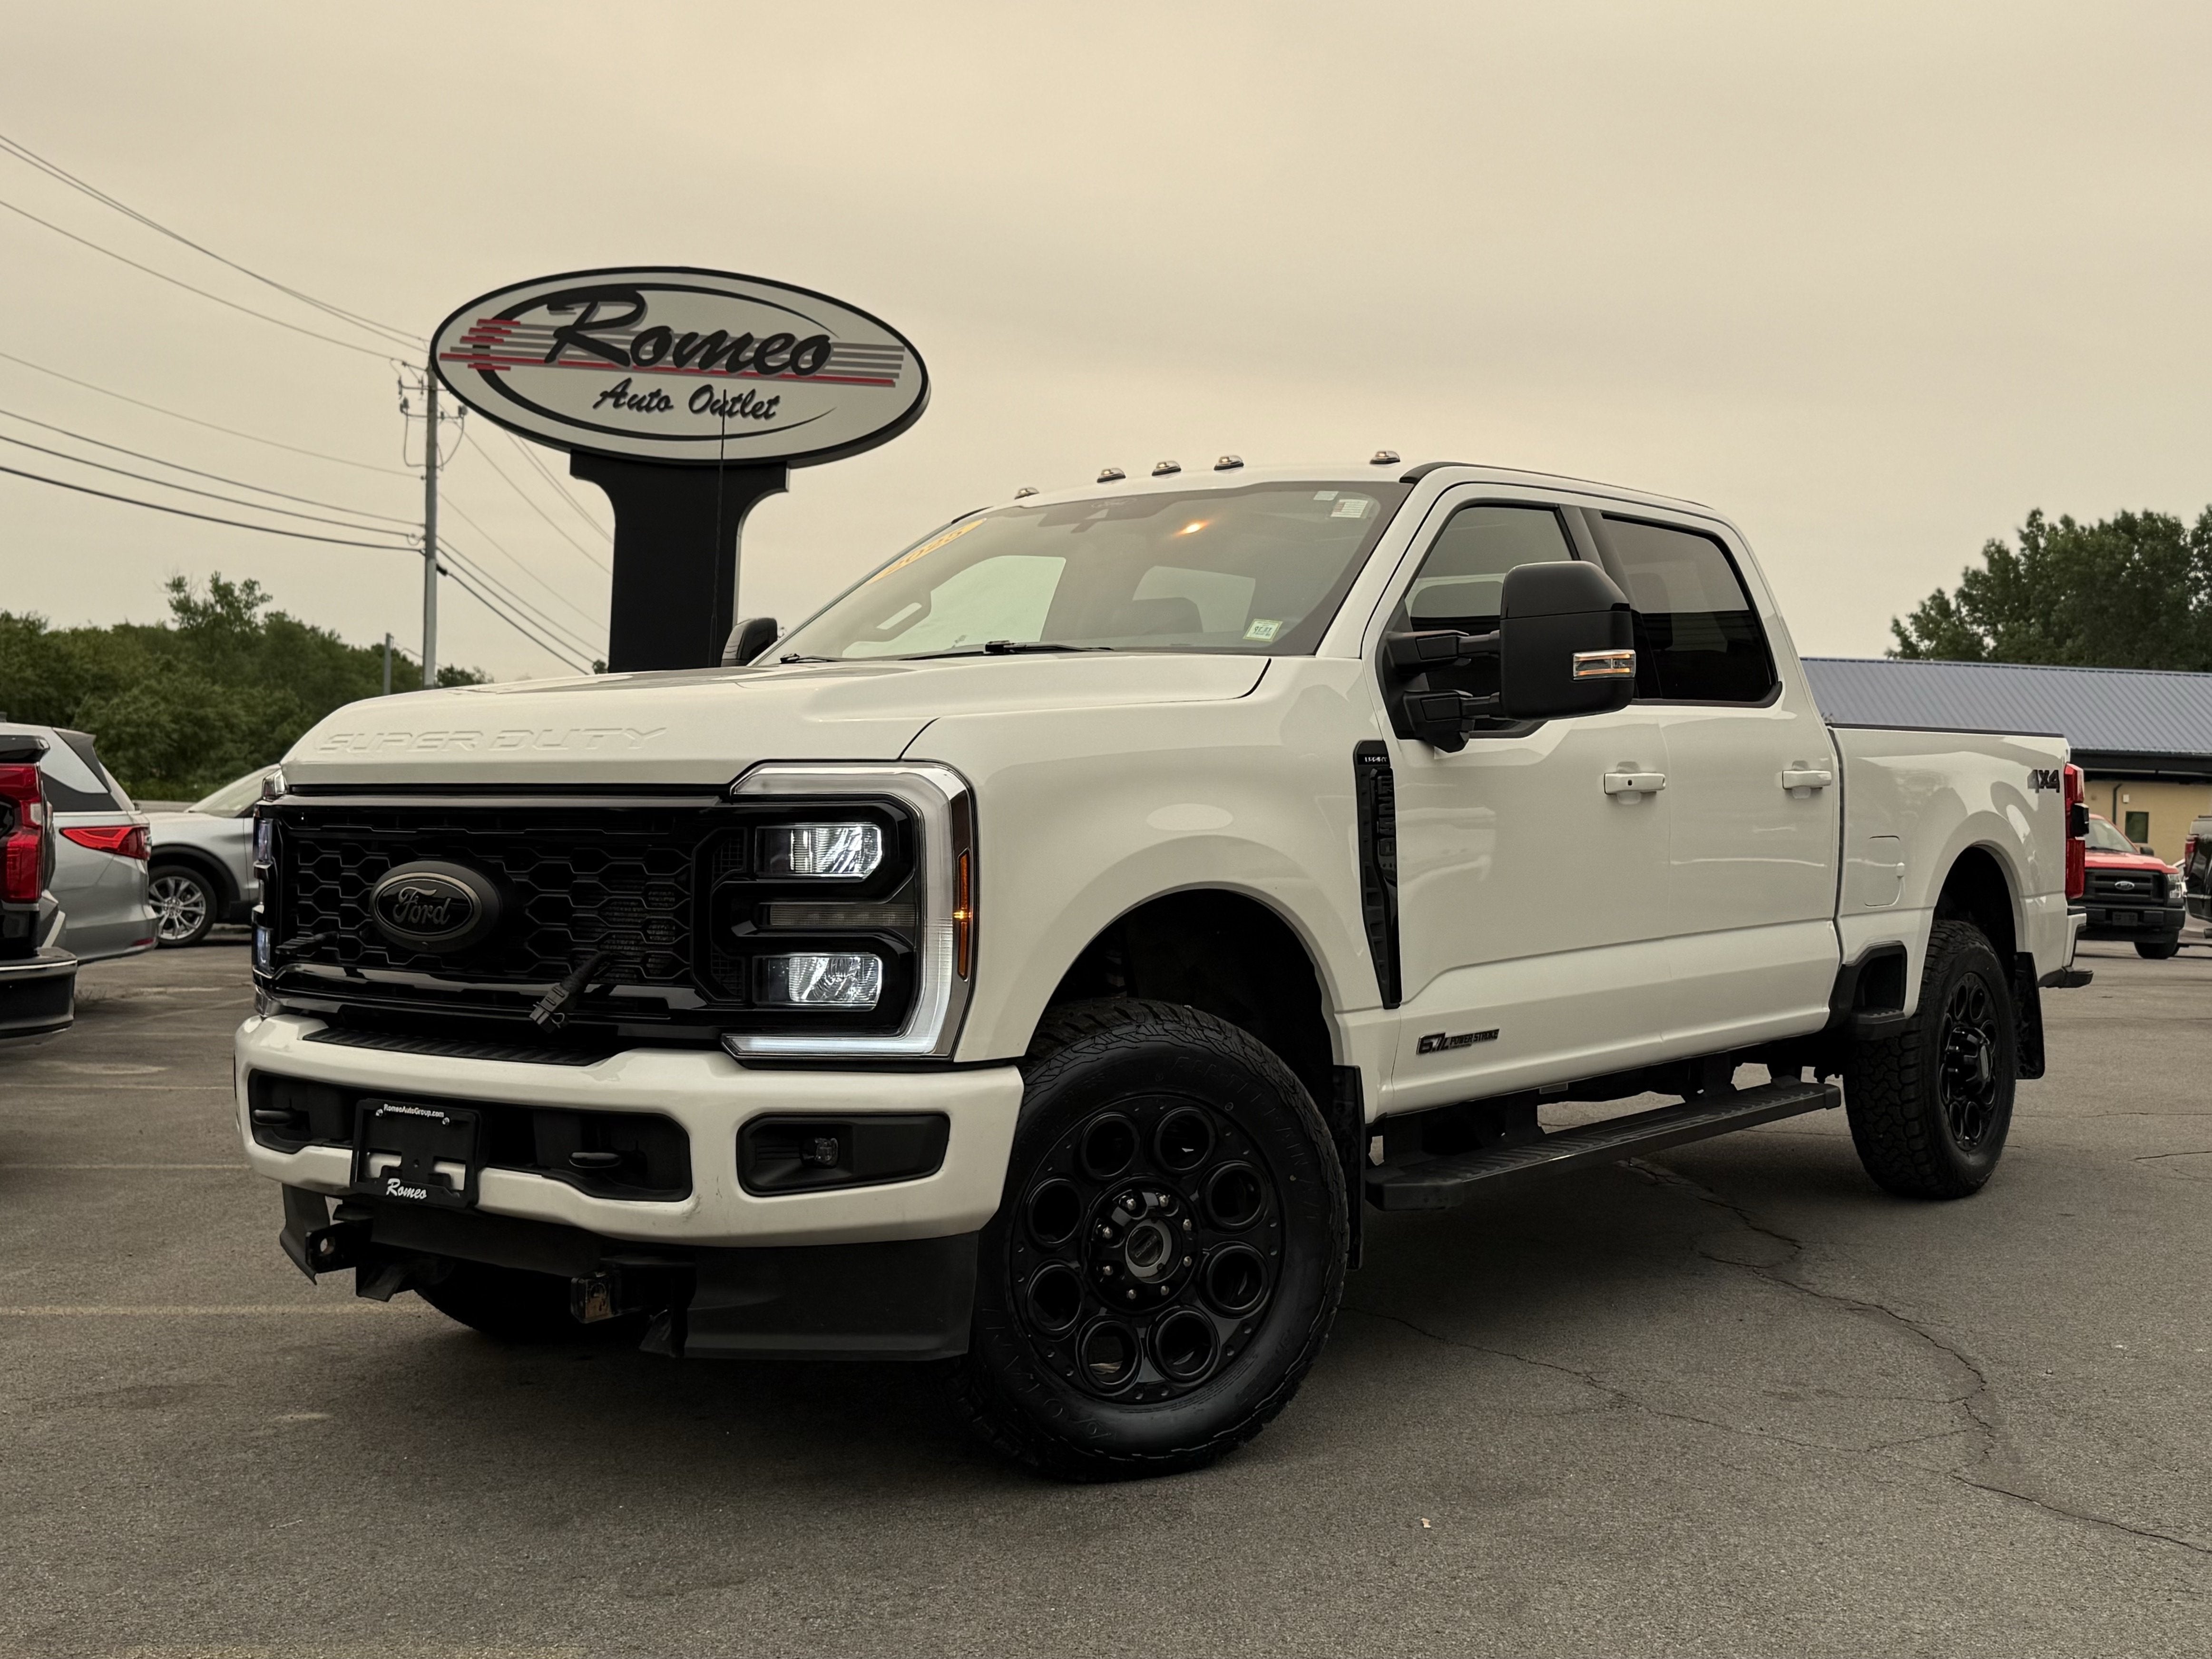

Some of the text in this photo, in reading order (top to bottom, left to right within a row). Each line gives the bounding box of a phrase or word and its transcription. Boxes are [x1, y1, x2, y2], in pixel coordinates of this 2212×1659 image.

[544, 285, 832, 375] Romeo
[593, 377, 780, 420] Auto Outlet
[316, 728, 667, 753] SUPER DUTY
[392, 887, 451, 925] Ford
[1450, 1034, 1473, 1046] POWER
[383, 1103, 444, 1117] RomeoAutoGroup.com
[386, 1178, 427, 1199] Romeo
